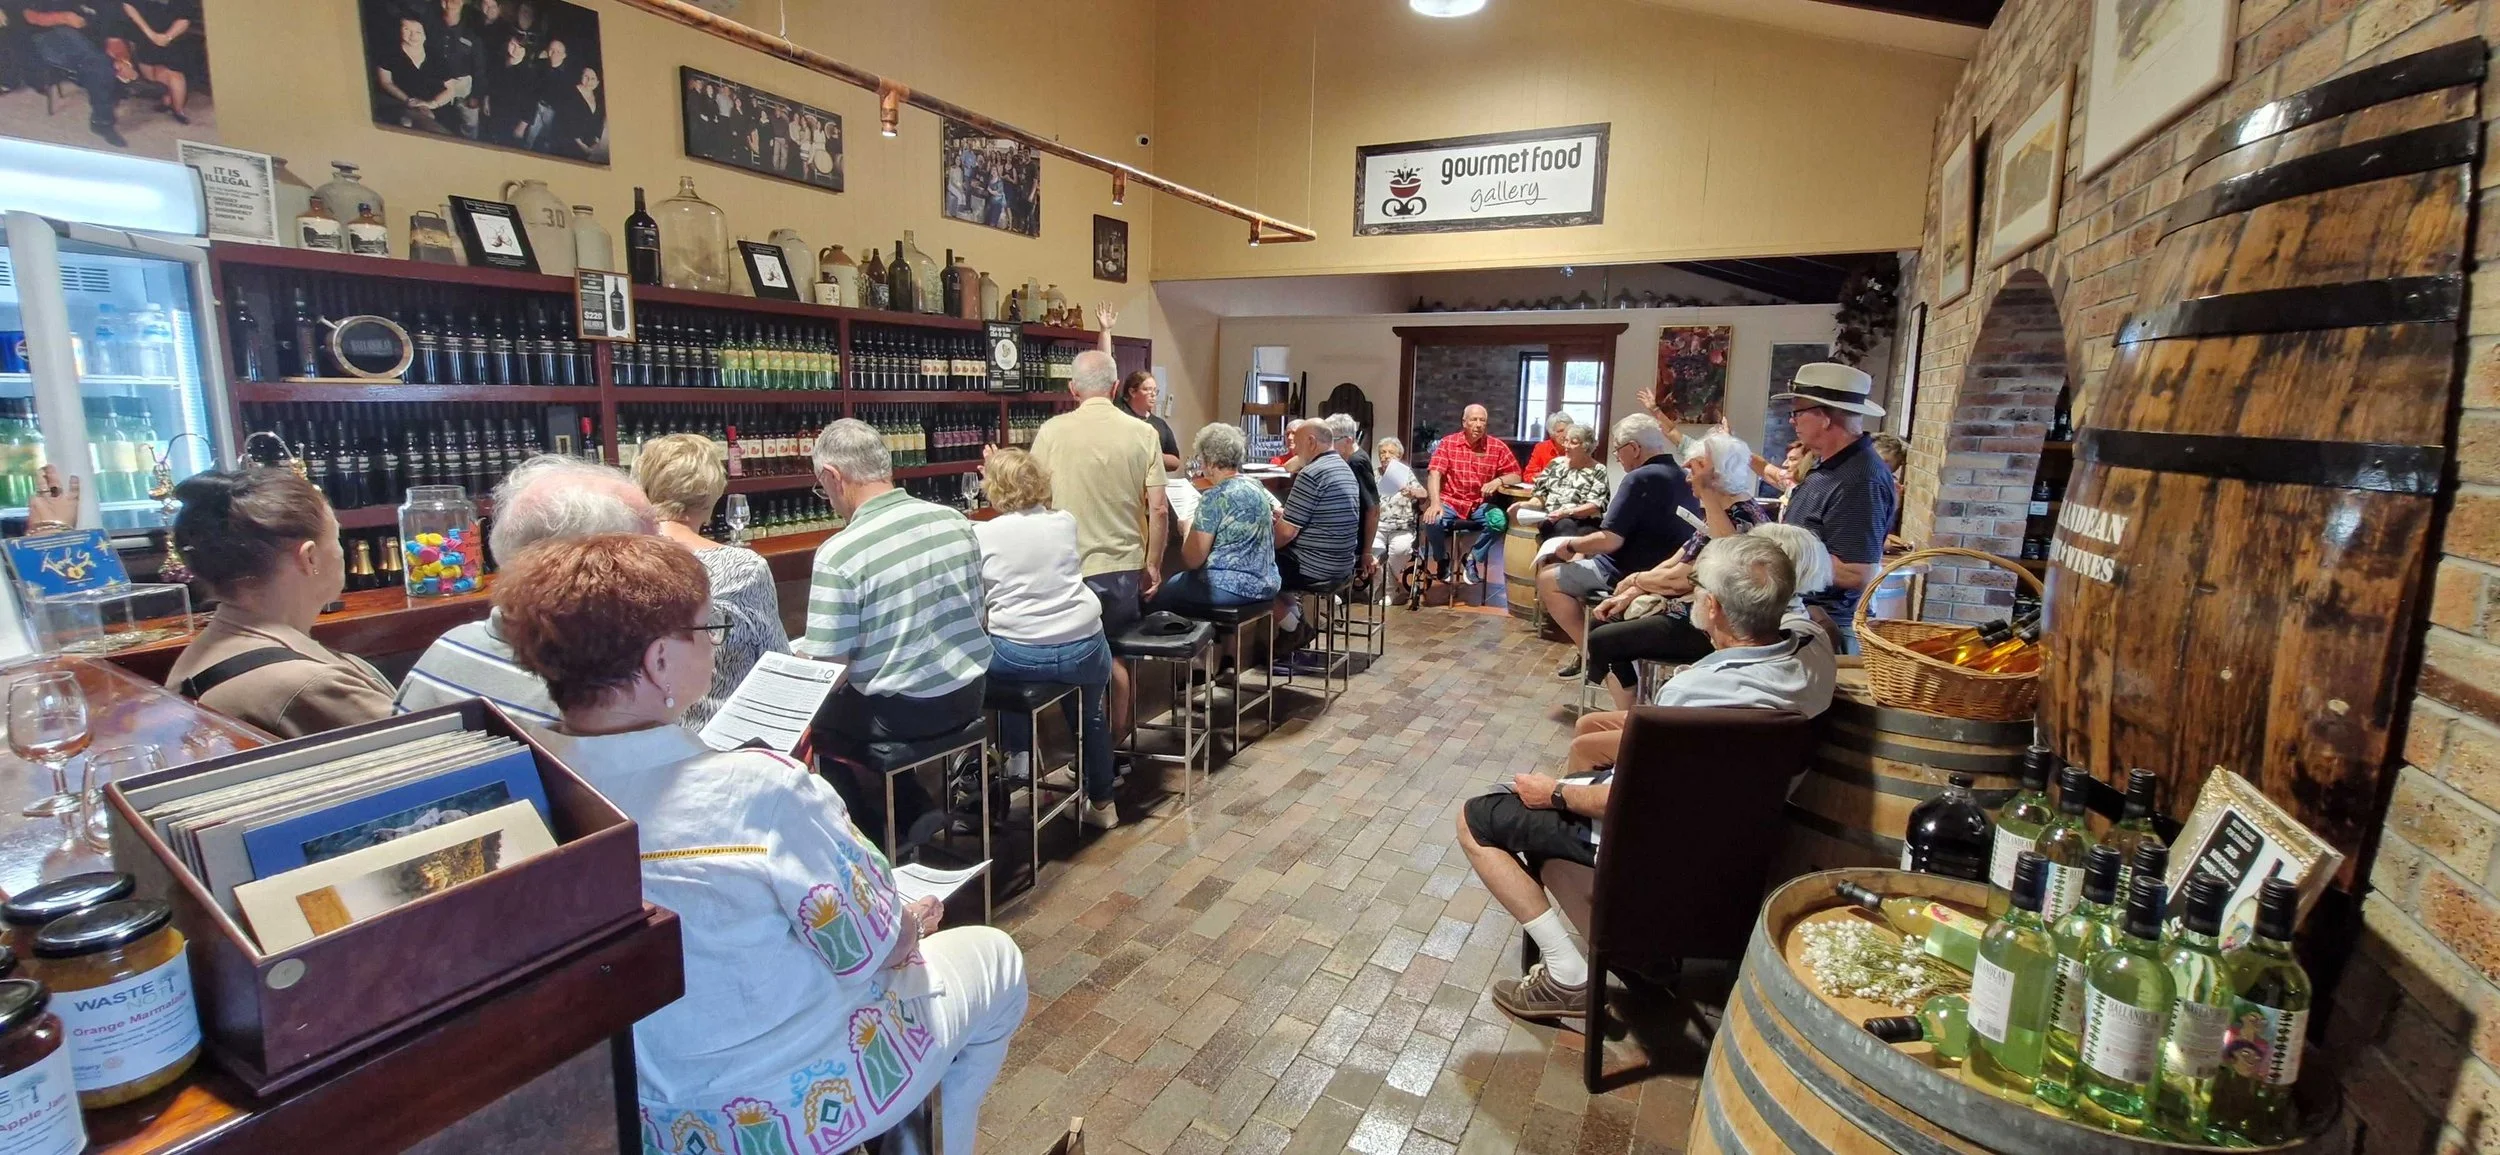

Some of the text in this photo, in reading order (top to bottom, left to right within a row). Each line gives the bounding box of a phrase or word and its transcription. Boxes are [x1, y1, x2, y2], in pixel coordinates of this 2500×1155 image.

[214, 166, 240, 177] IT IS
[1441, 142, 1582, 185] gourmet food
[204, 173, 251, 188] ILLEGAL
[1470, 180, 1541, 212] gallery
[583, 310, 603, 320] $220
[2065, 545, 2115, 583] WINES
[74, 980, 154, 1012] WASTE
[73, 1019, 125, 1037] Orange
